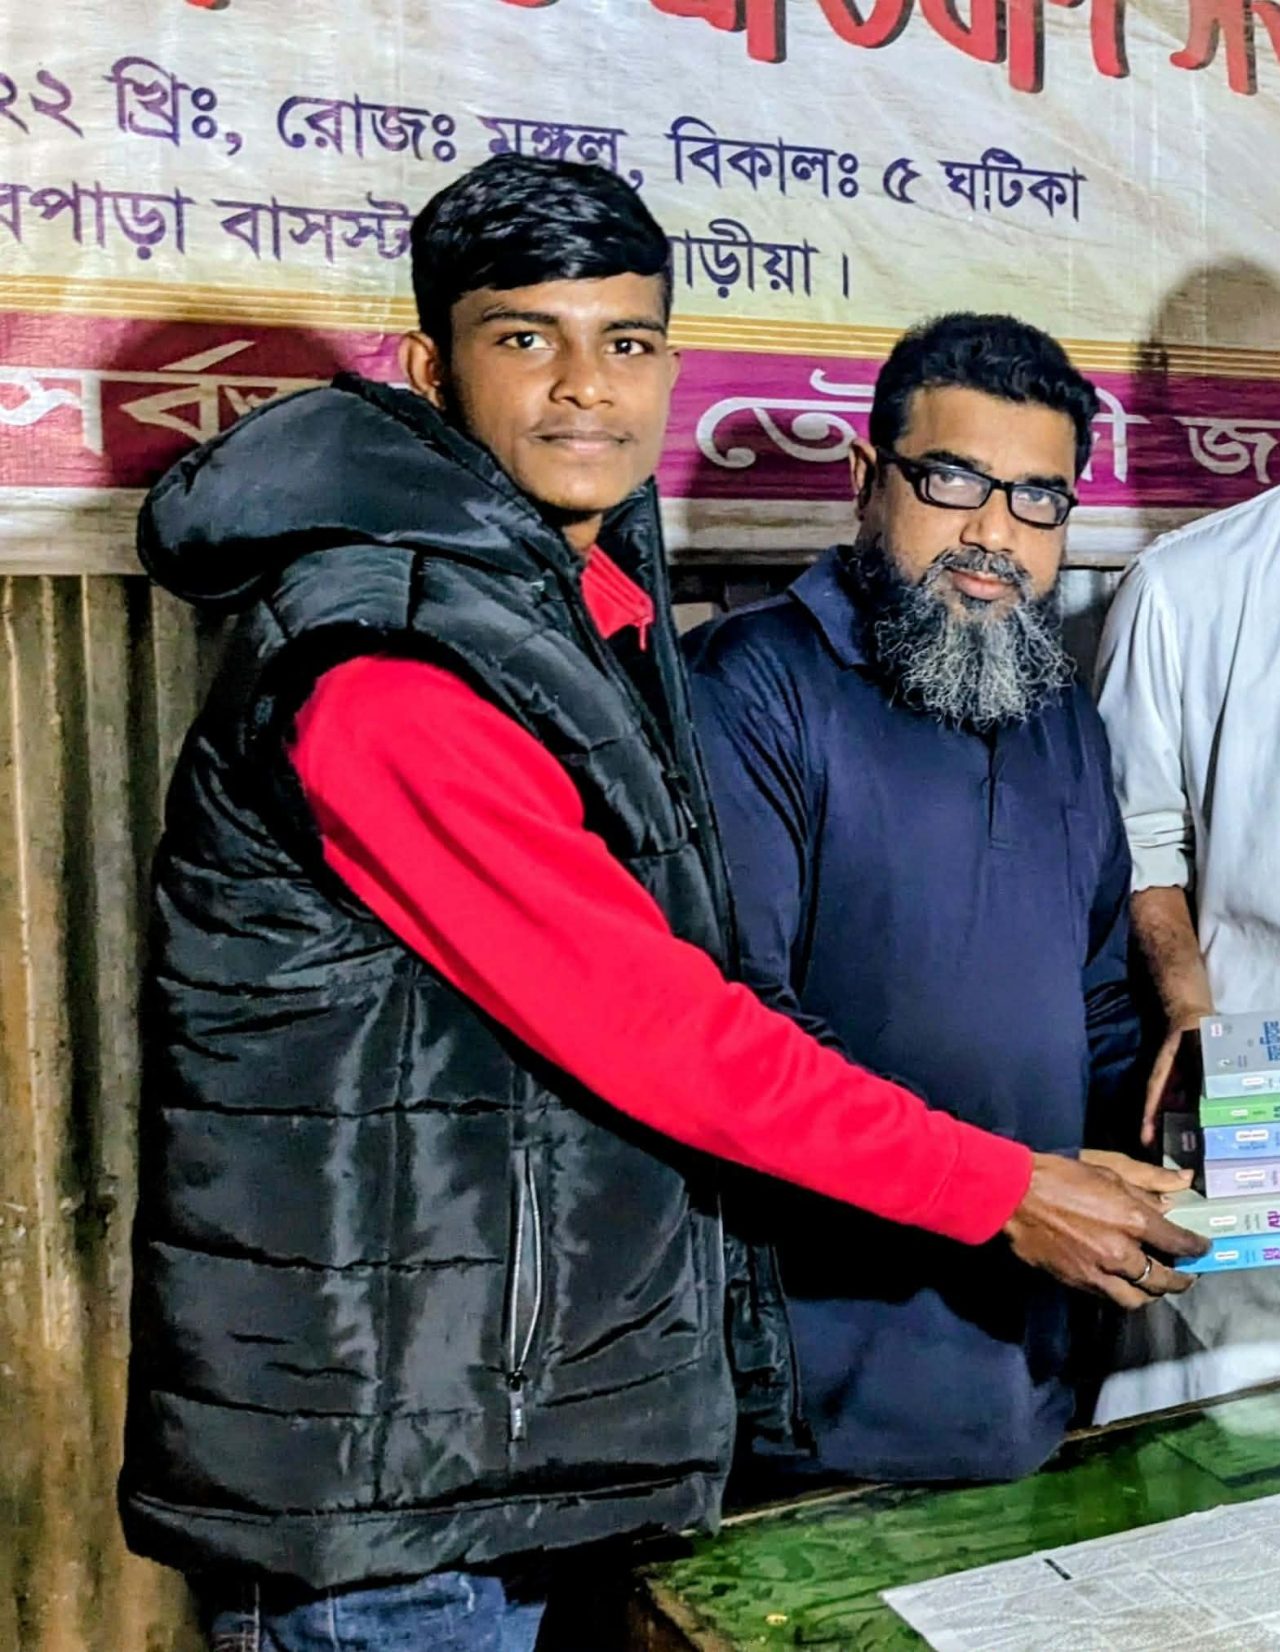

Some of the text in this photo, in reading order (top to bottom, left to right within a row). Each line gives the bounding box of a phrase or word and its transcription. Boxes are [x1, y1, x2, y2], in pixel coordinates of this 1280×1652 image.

[883, 157, 922, 205] ৫
[938, 147, 1087, 222] ঘটিকা
[663, 218, 820, 298] াড়ীয়া
